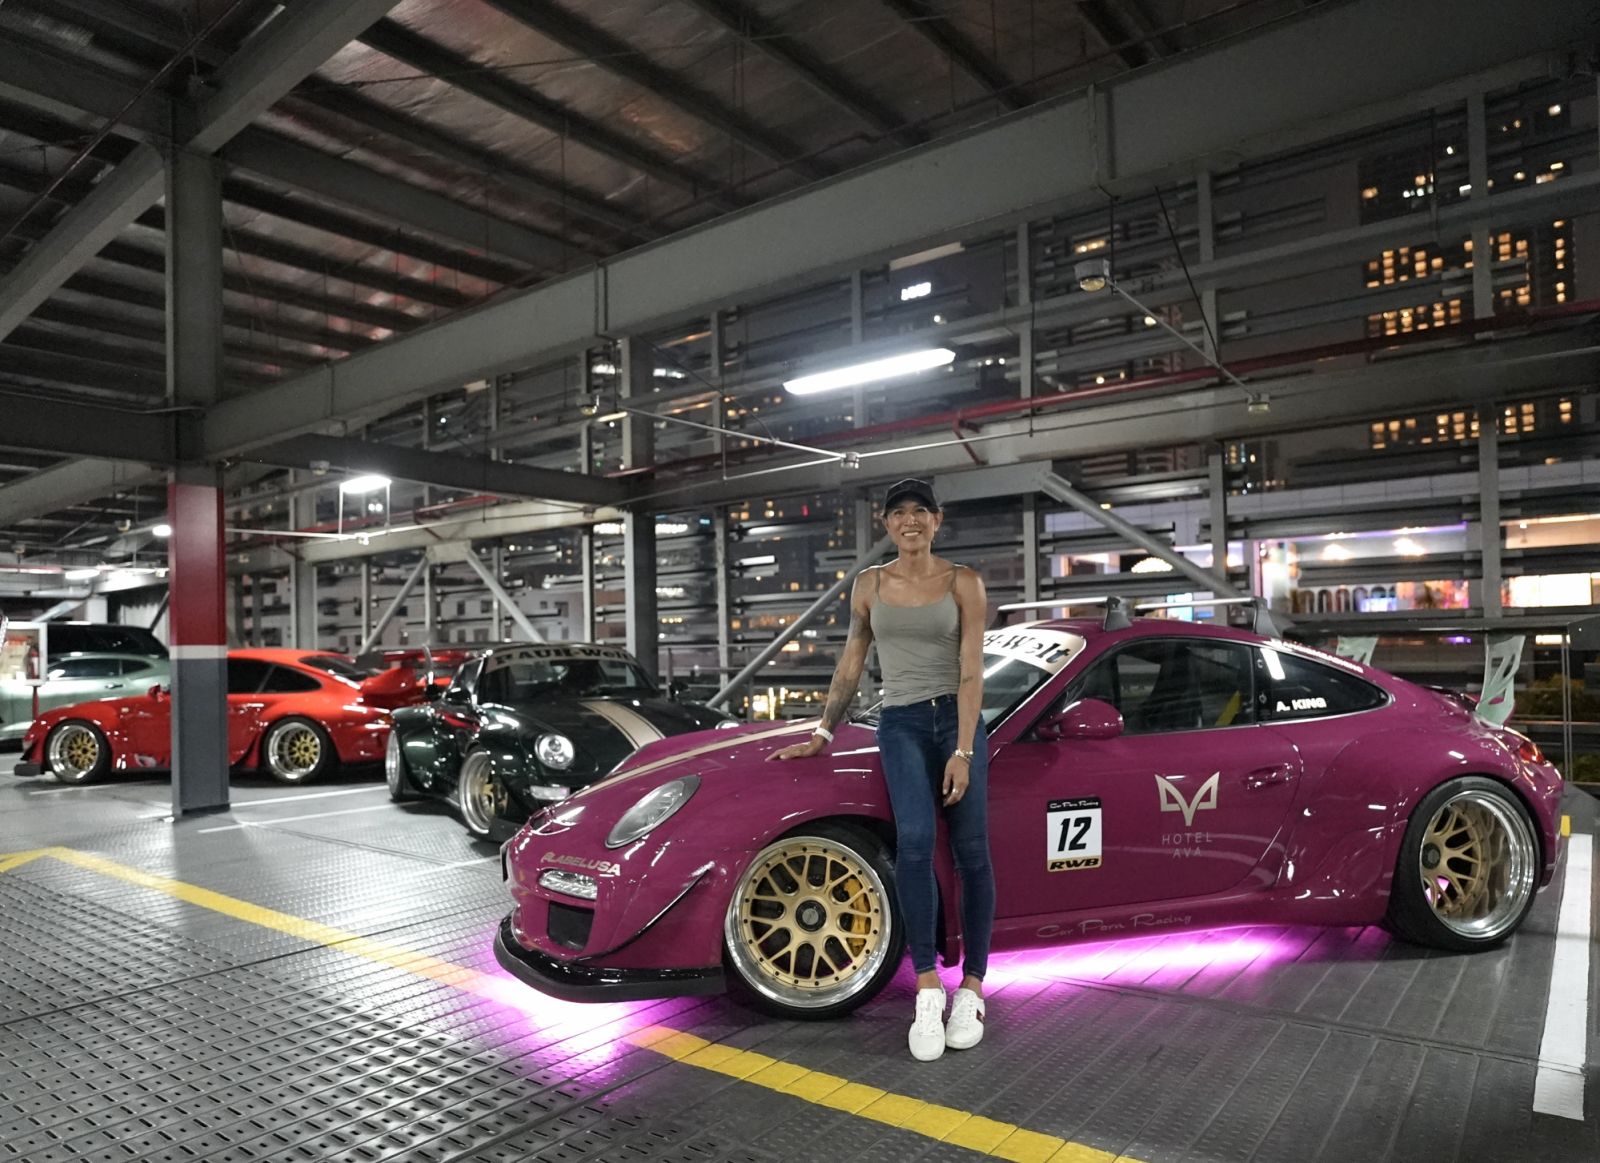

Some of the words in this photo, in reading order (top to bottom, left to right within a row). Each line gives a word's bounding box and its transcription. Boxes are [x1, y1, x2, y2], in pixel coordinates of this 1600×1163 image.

[1276, 701, 1290, 712] A.
[1292, 697, 1327, 710] KING
[1057, 816, 1092, 852] 12
[1162, 831, 1212, 845] HOTEL
[1173, 846, 1202, 858] AVA
[1049, 858, 1100, 870] RWB
[1036, 924, 1074, 938] Car
[1078, 919, 1125, 934] Porn
[1130, 913, 1192, 926] Racing
